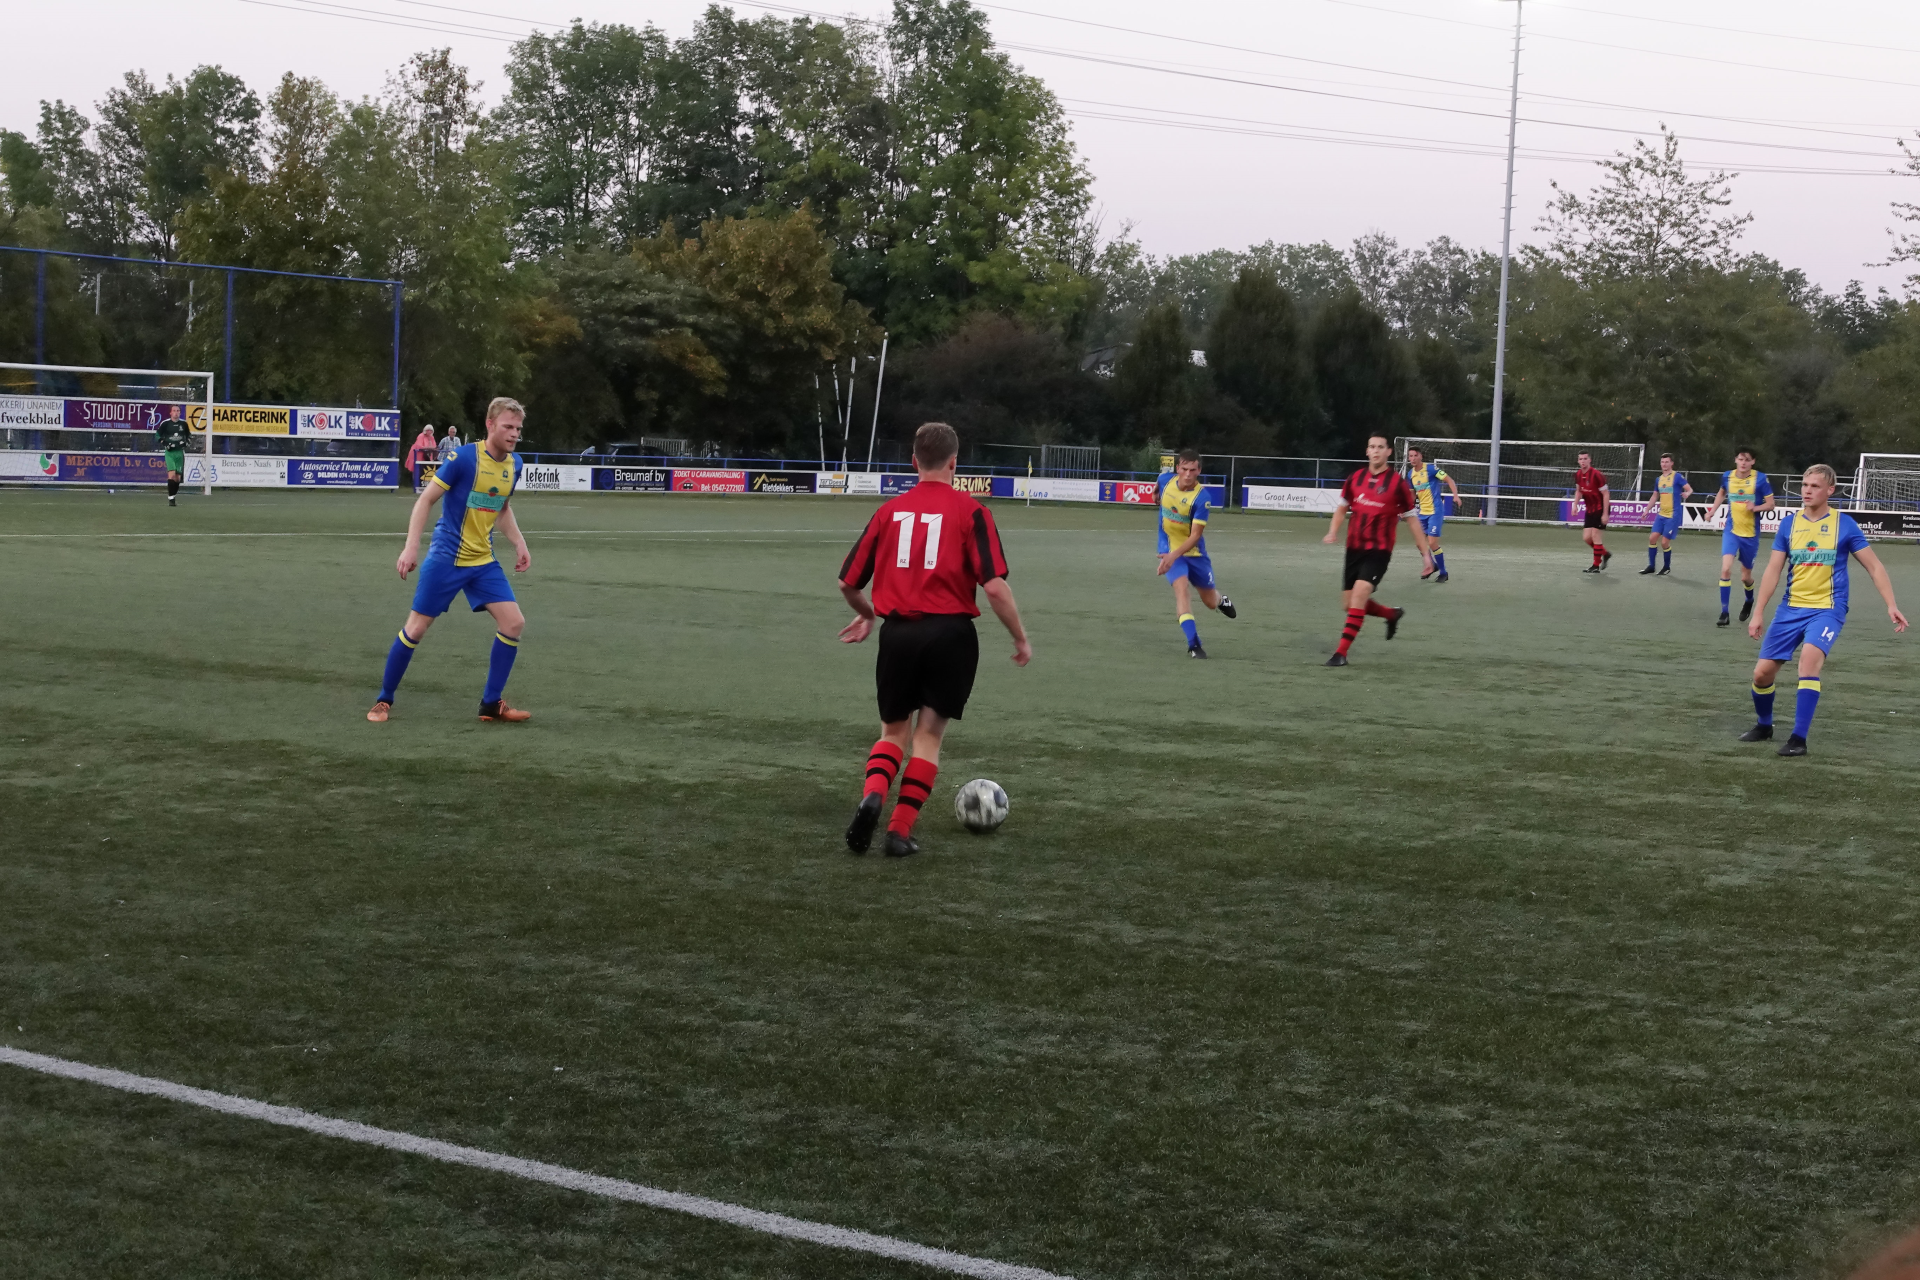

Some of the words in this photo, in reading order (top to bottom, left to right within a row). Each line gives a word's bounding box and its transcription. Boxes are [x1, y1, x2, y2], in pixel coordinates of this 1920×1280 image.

[27, 401, 62, 410] UNANIEM
[83, 402, 124, 421] STUDIO
[129, 403, 143, 421] PT
[212, 409, 287, 424] HARTGERINK
[66, 455, 120, 467] MERCOM
[222, 459, 247, 467] Berends
[254, 460, 271, 468] Naafs
[275, 460, 286, 468] BV
[298, 461, 340, 471] Autoservice
[341, 462, 361, 471] Thom
[362, 462, 371, 471] de
[371, 462, 389, 474] Jong
[615, 469, 653, 482] Breumaf
[655, 470, 665, 482] bv
[674, 470, 690, 478] ZOEKT
[696, 471, 741, 479] CARAVANSTALLING
[712, 484, 745, 492] 0547-272107
[953, 477, 991, 492] BRUINS
[1015, 488, 1025, 497] La
[1029, 489, 1048, 498] Luna
[1264, 493, 1285, 501] Groot
[1286, 493, 1307, 502] Avest
[892, 511, 943, 569] 11
[1821, 626, 1835, 642] 14
